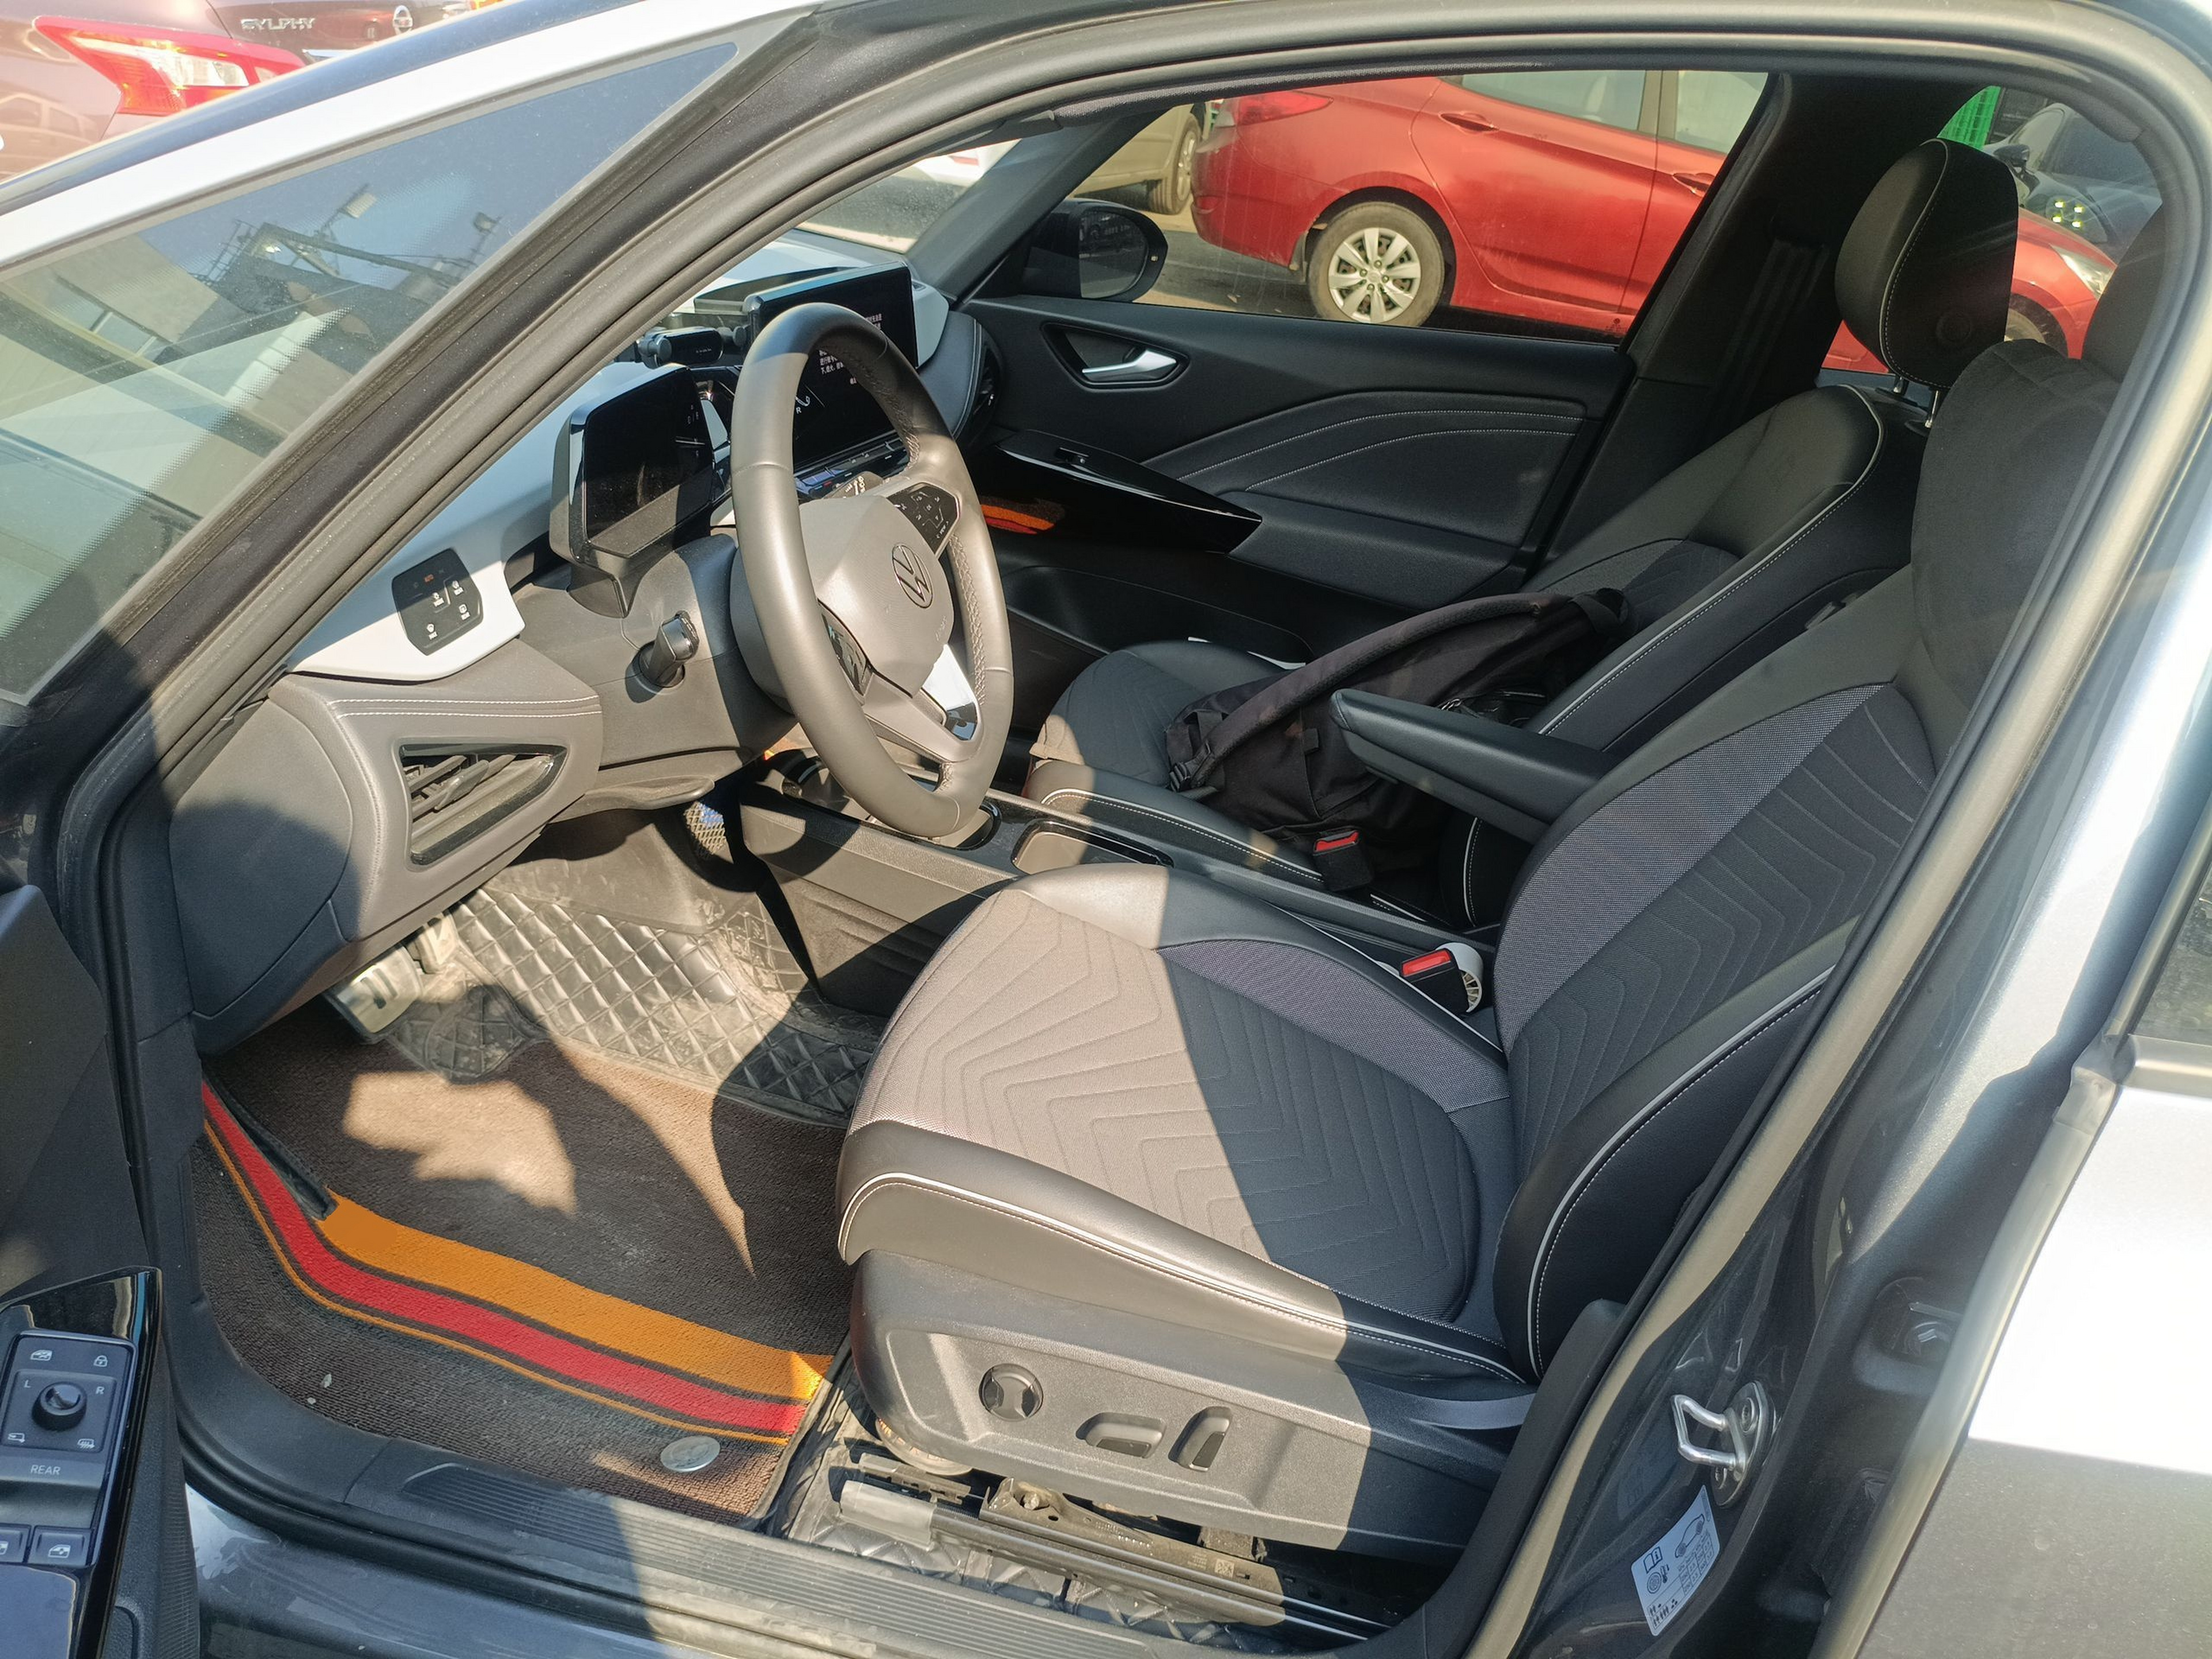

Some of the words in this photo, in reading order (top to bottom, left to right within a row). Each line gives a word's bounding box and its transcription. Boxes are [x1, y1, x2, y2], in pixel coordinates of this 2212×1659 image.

[240, 18, 316, 31] SYLPHY
[24, 1380, 31, 1388] L
[95, 1386, 105, 1395] R
[30, 1464, 62, 1475] REAR
